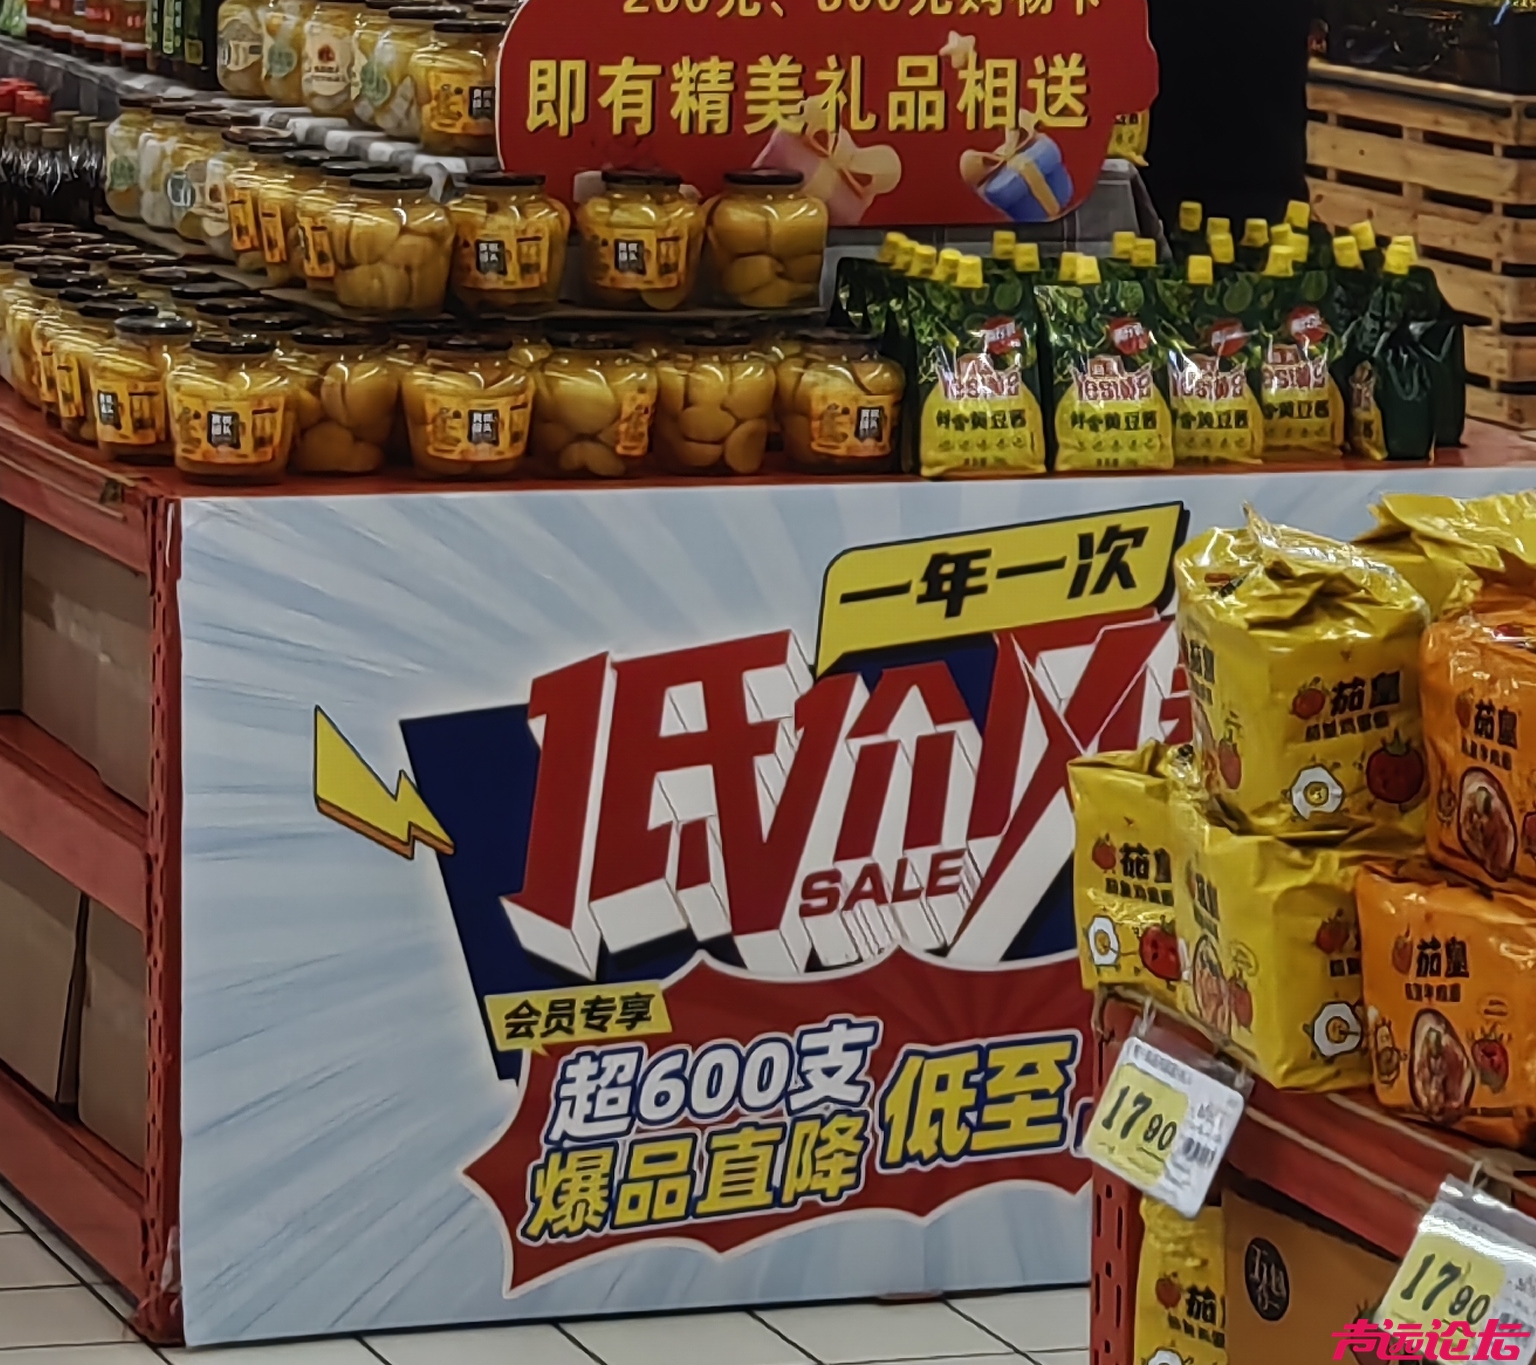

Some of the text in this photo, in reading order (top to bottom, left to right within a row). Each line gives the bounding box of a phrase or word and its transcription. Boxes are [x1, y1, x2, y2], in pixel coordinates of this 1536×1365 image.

[527, 54, 1090, 136] 即有精美礼品相送
[839, 525, 1150, 621] 一年一次
[520, 614, 1194, 936] 低价风
[799, 849, 967, 918] SALE
[503, 996, 654, 1040] 会员专享
[553, 1022, 881, 1141] 超600支
[882, 1036, 1080, 1165] 低至
[526, 1117, 868, 1244] 爆品直降
